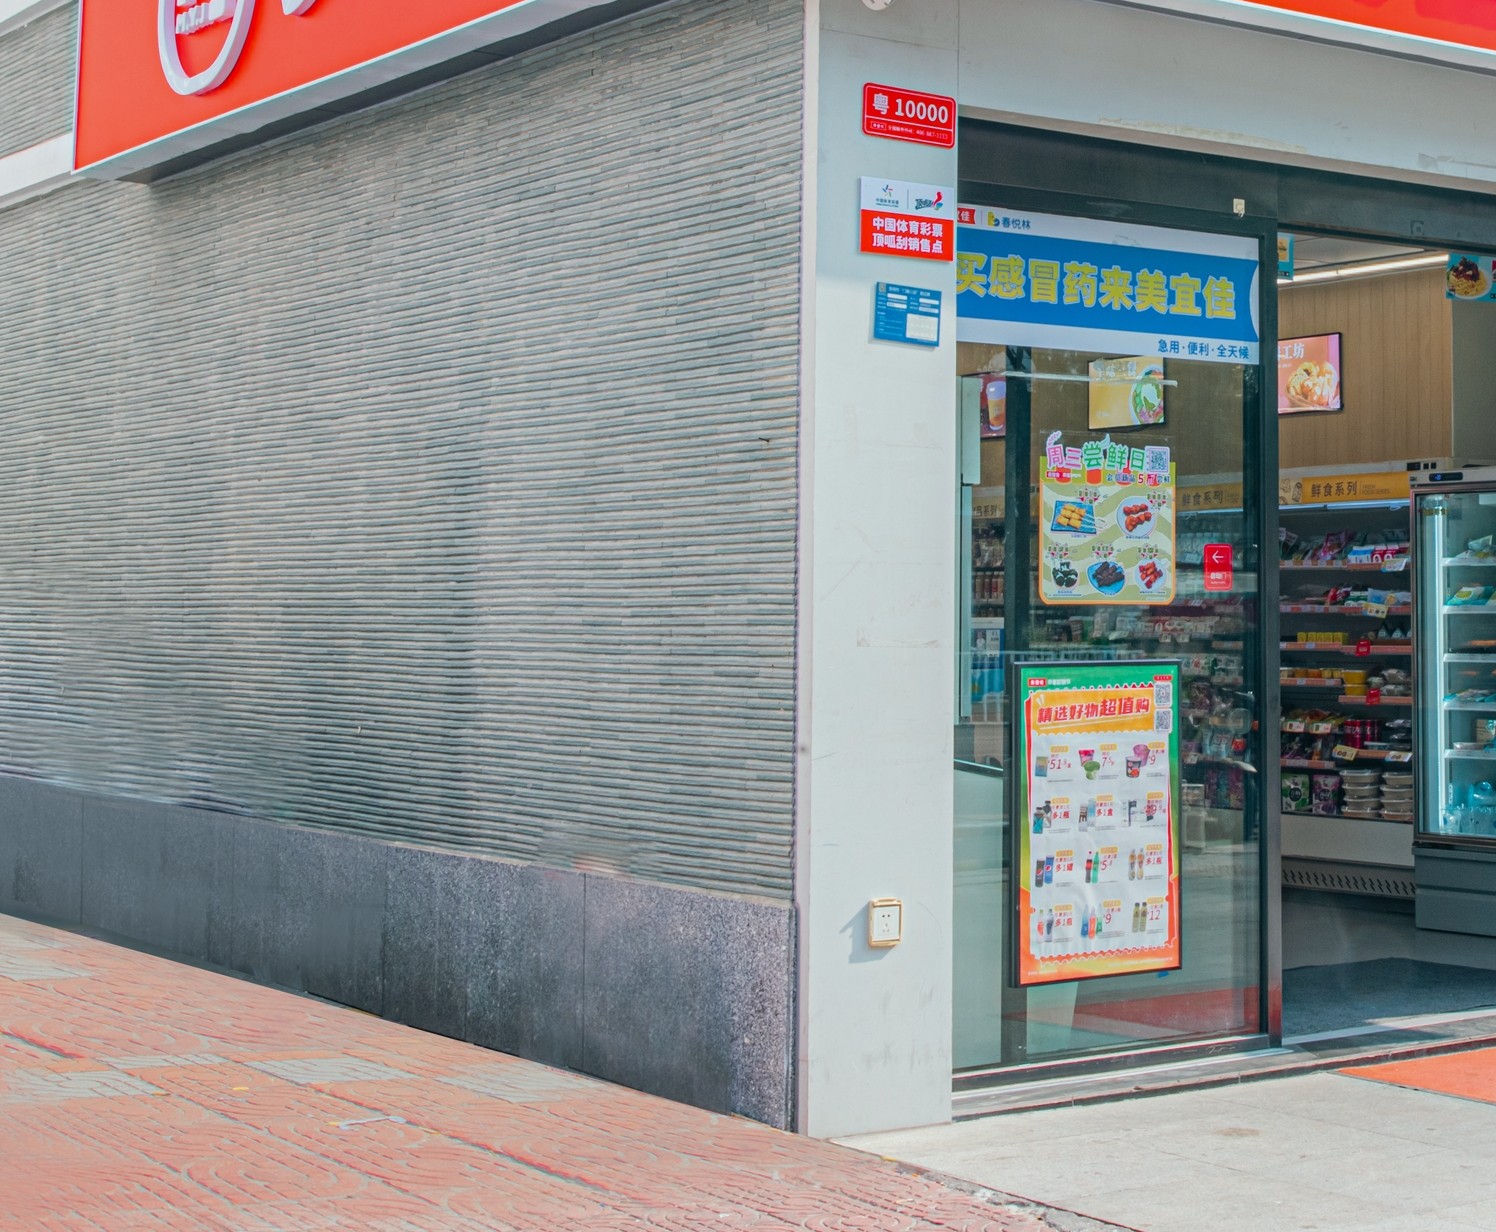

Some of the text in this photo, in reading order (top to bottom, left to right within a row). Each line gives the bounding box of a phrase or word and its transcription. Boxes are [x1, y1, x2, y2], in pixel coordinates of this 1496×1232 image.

[895, 98, 949, 124] 10000
[872, 216, 943, 237] 中国体育彩票
[1002, 217, 1031, 229] 春悦林
[872, 233, 943, 254] 顶呱刮销售点
[957, 251, 1236, 320] 买感冒药来美宜佳
[1046, 441, 1145, 471] 周三尝鲜日
[1311, 480, 1358, 498] 鲜食系列
[1037, 696, 1150, 724] 精选好物超值购
